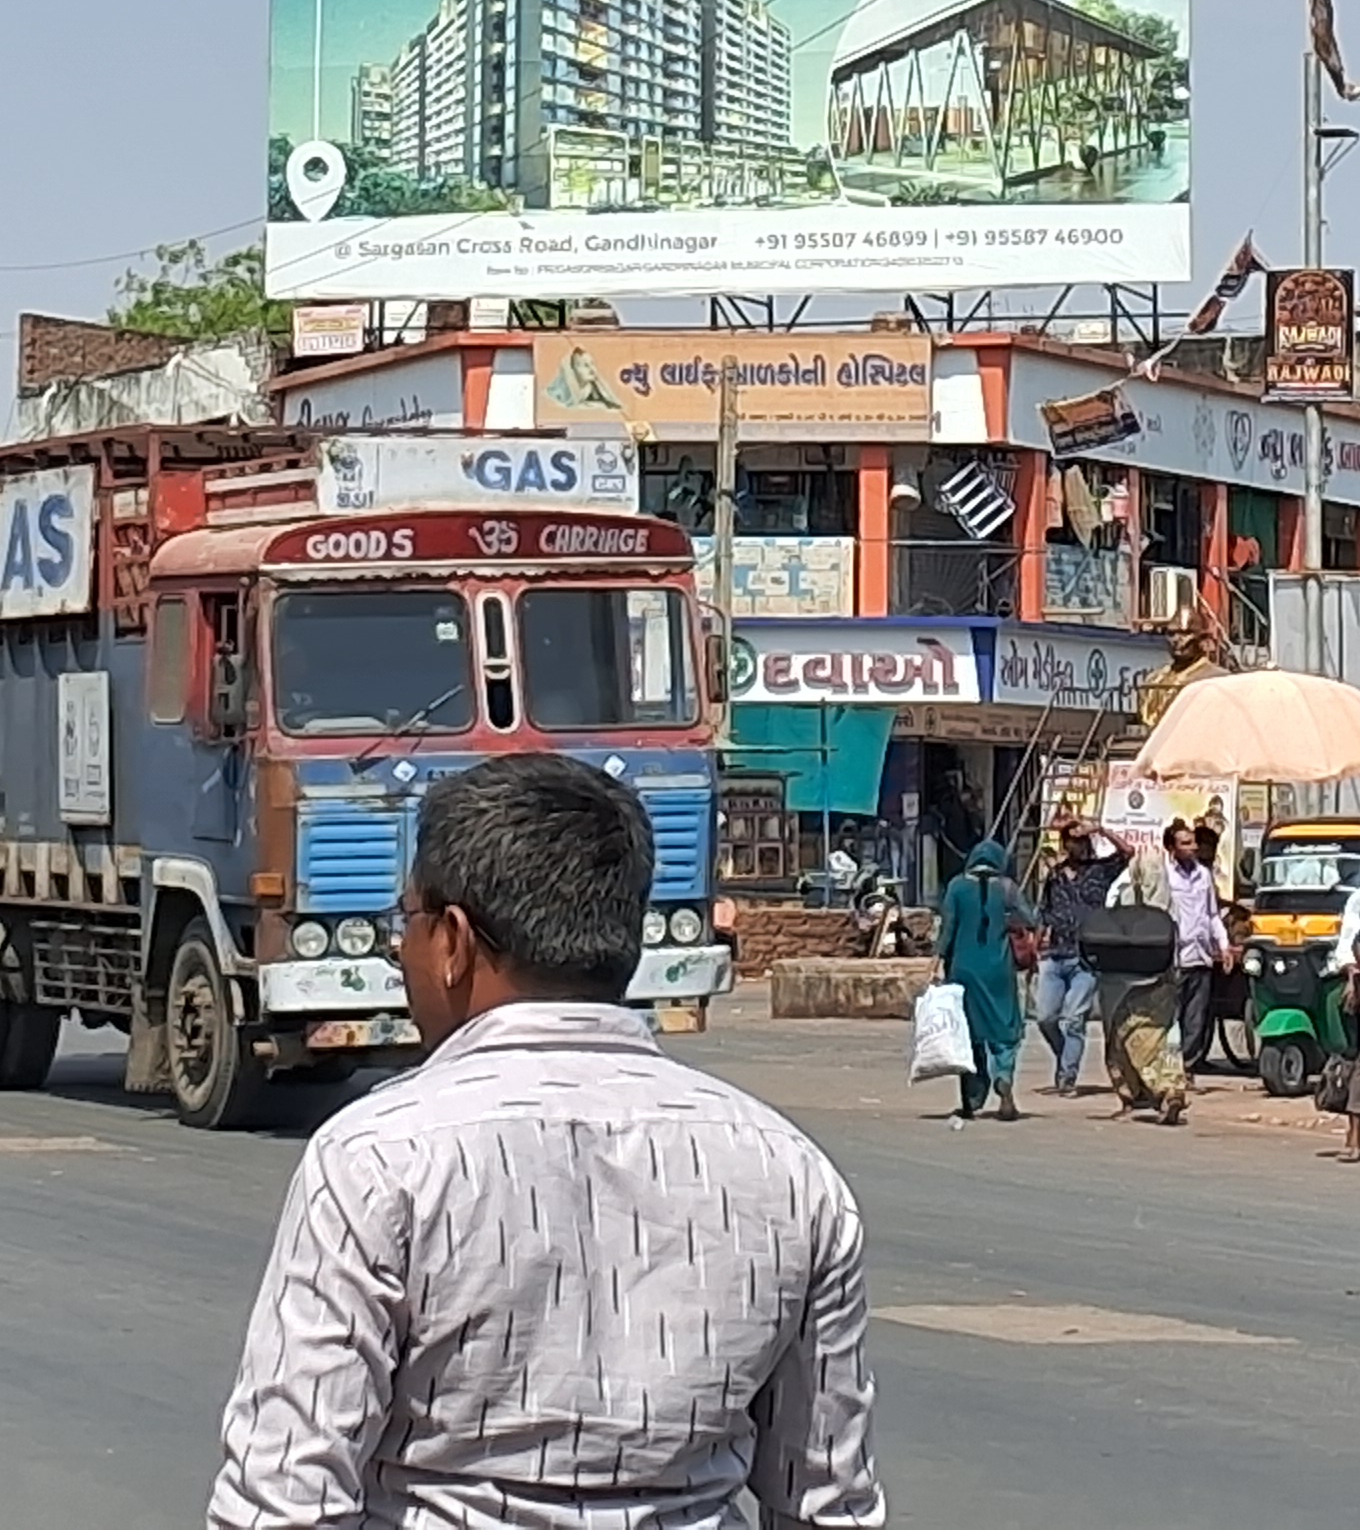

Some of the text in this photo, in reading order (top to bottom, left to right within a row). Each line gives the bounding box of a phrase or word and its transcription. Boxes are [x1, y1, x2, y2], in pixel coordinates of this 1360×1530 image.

[358, 240, 450, 260] Sargasan
[457, 237, 511, 255] Cross
[520, 235, 578, 254] Road,
[585, 233, 718, 253] Gandhinagar
[754, 234, 787, 250] +91
[945, 230, 978, 247] +91
[1054, 228, 1124, 245] 46900
[475, 450, 578, 492] GAS
[306, 529, 415, 559] GOODS
[539, 524, 649, 553] CARRIAGE
[764, 637, 959, 696] દવાઓ
